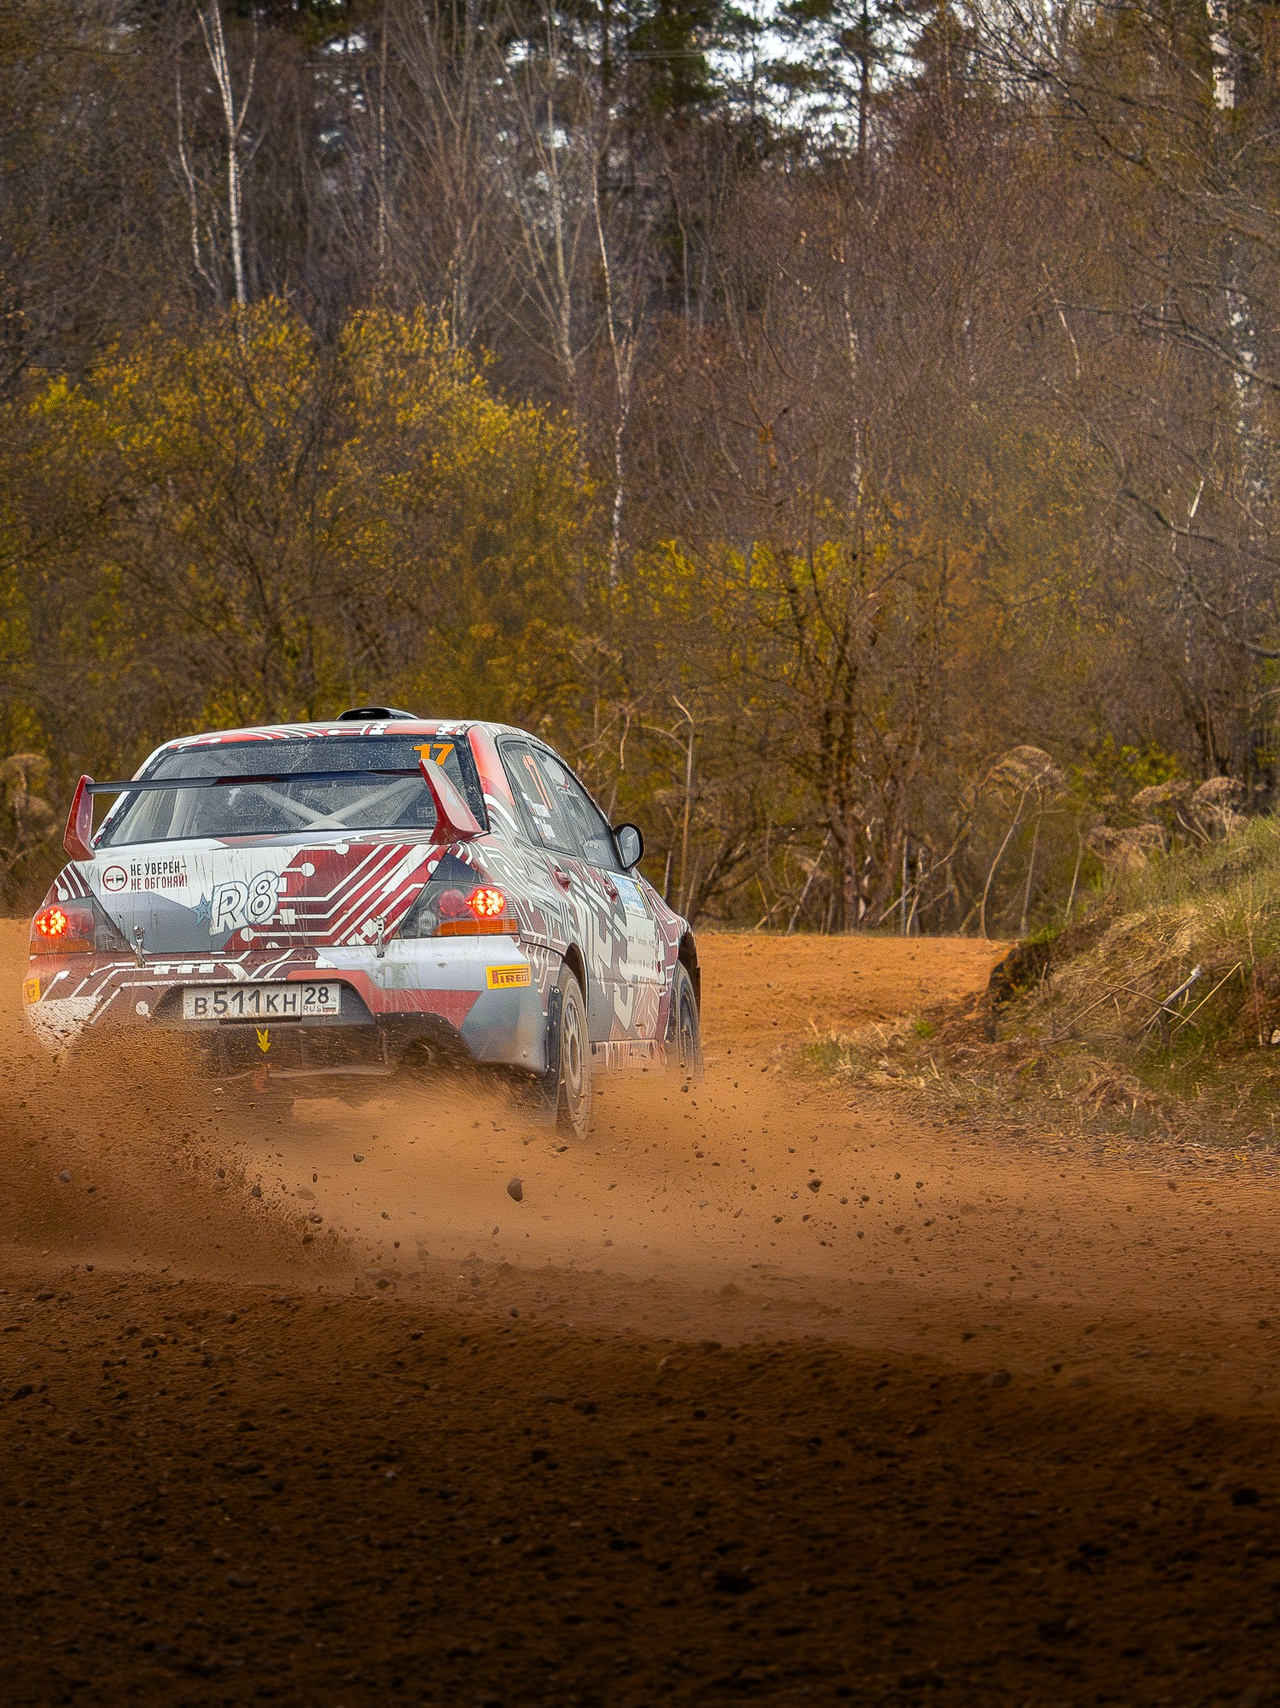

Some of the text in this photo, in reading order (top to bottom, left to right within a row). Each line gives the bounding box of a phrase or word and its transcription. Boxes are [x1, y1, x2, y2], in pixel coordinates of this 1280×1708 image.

[414, 744, 455, 766] 17
[130, 864, 141, 876] НЕ
[131, 874, 188, 890] НЕ ОБГОНЯЙ!
[210, 870, 280, 936] R8
[304, 987, 330, 1004] 28
[303, 1004, 322, 1013] RUS
